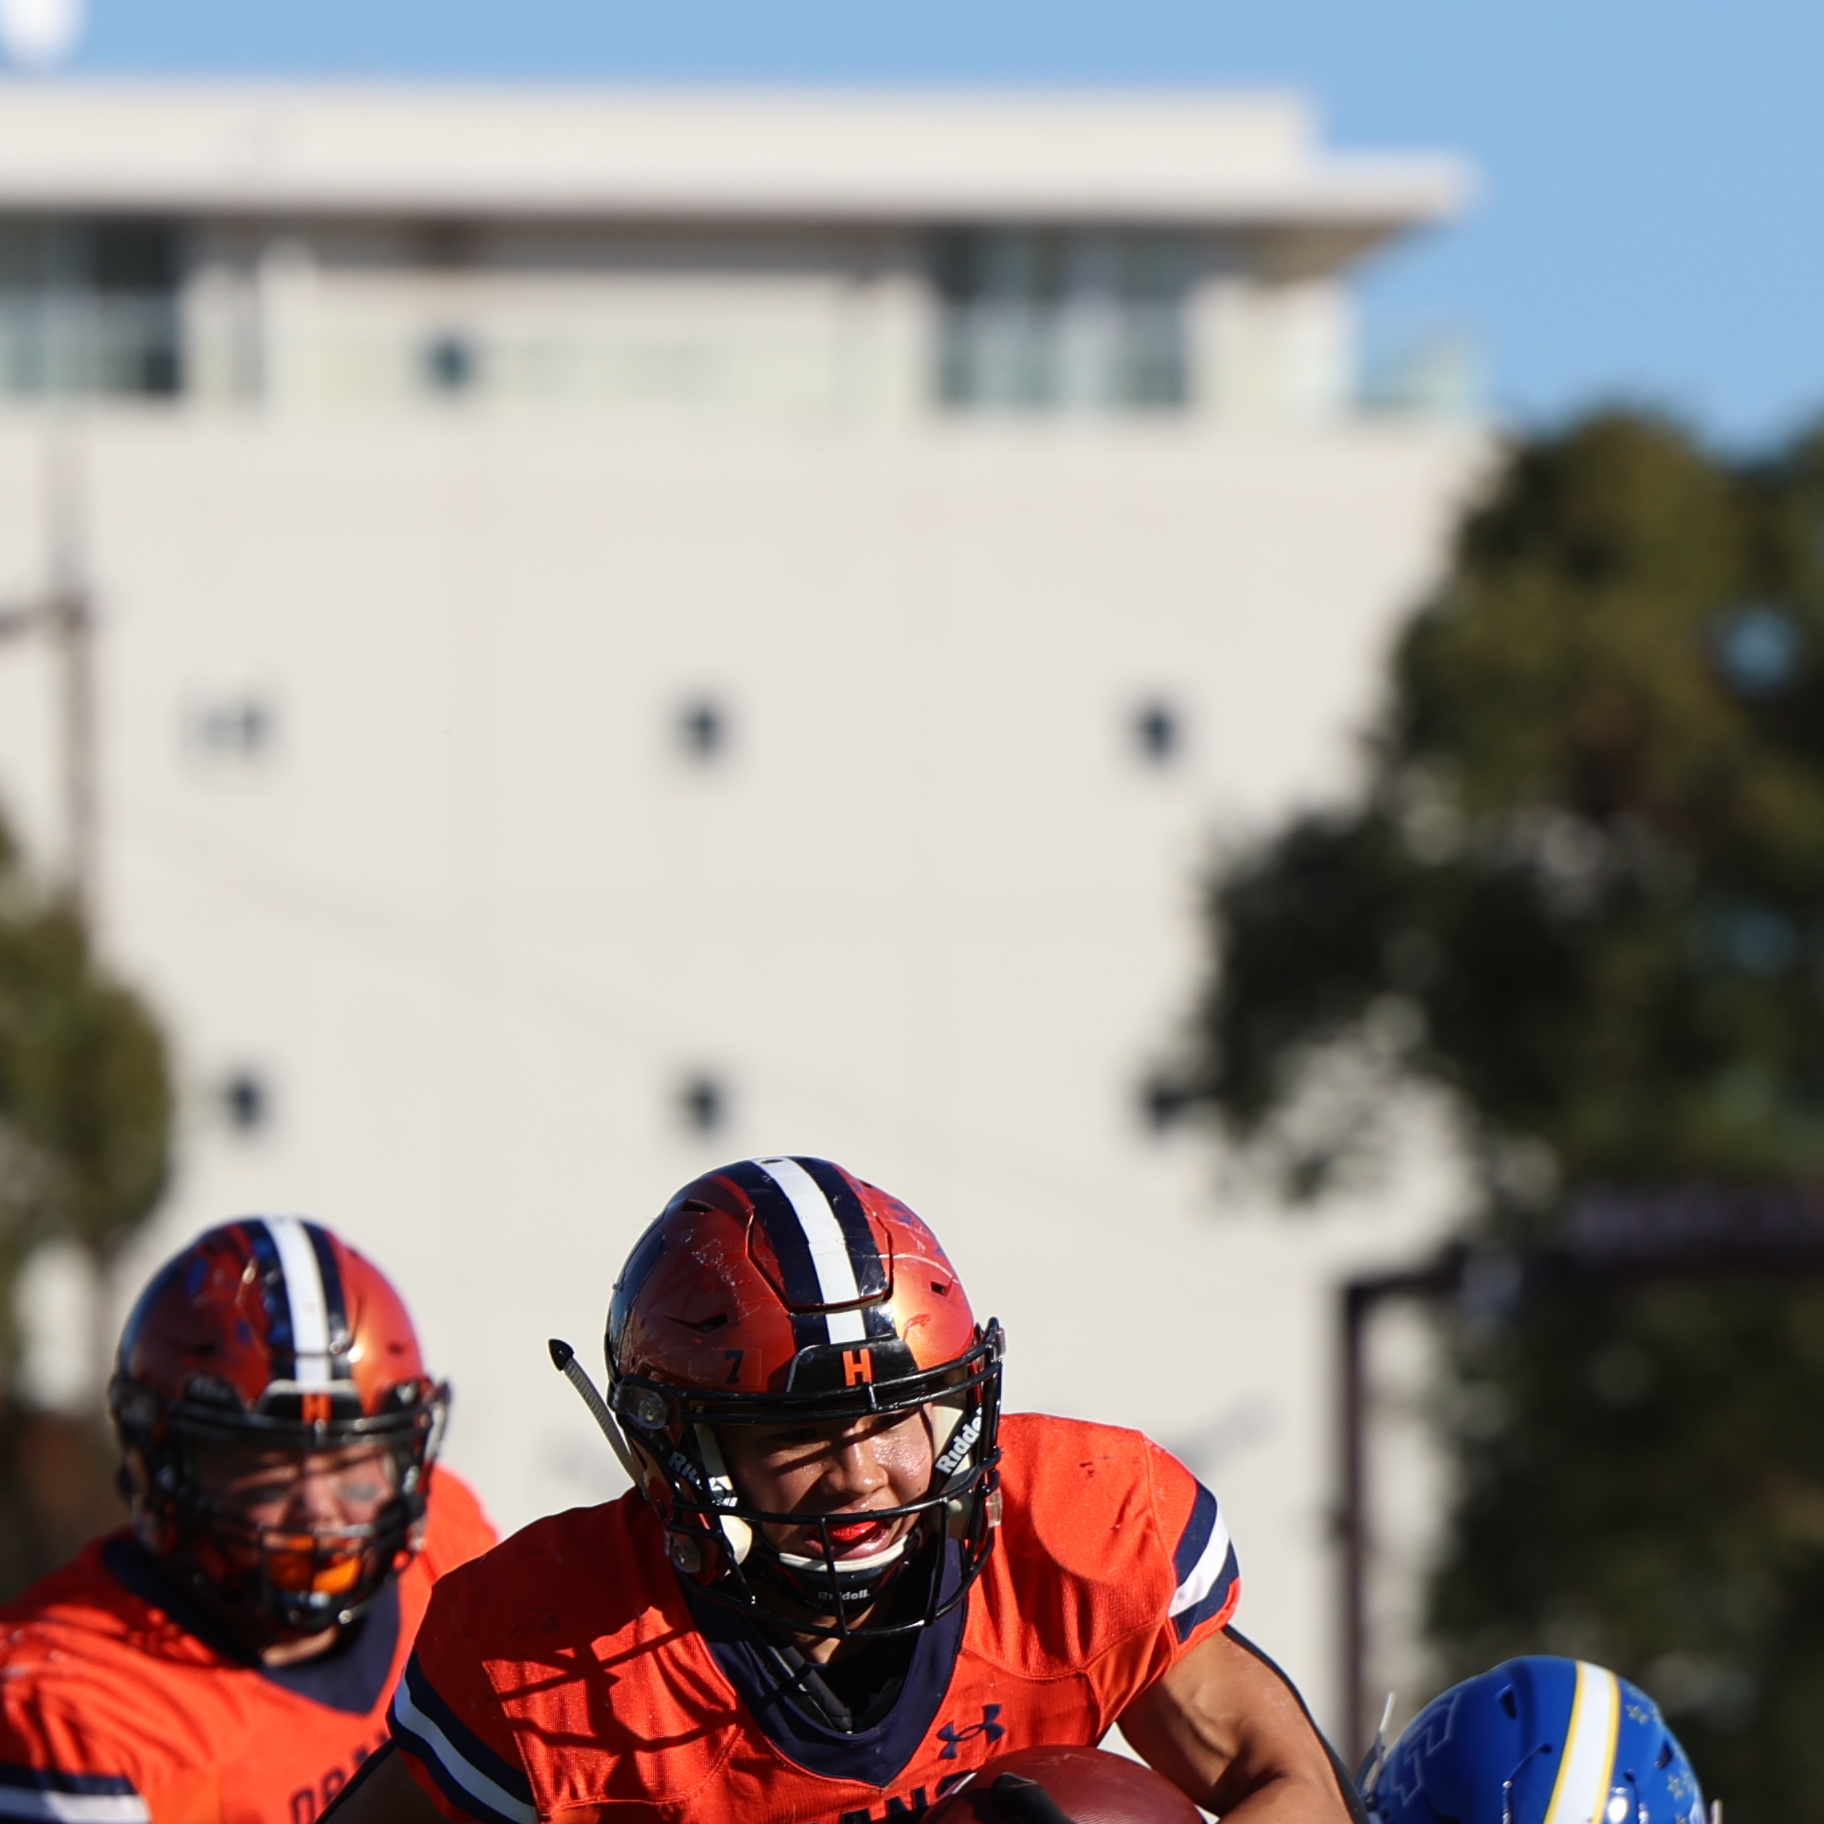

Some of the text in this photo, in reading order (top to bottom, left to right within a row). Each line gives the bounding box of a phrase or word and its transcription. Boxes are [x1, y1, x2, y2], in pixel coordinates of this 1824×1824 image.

[724, 1349, 744, 1384] 7
[842, 1348, 872, 1386] H
[302, 1391, 332, 1425] H
